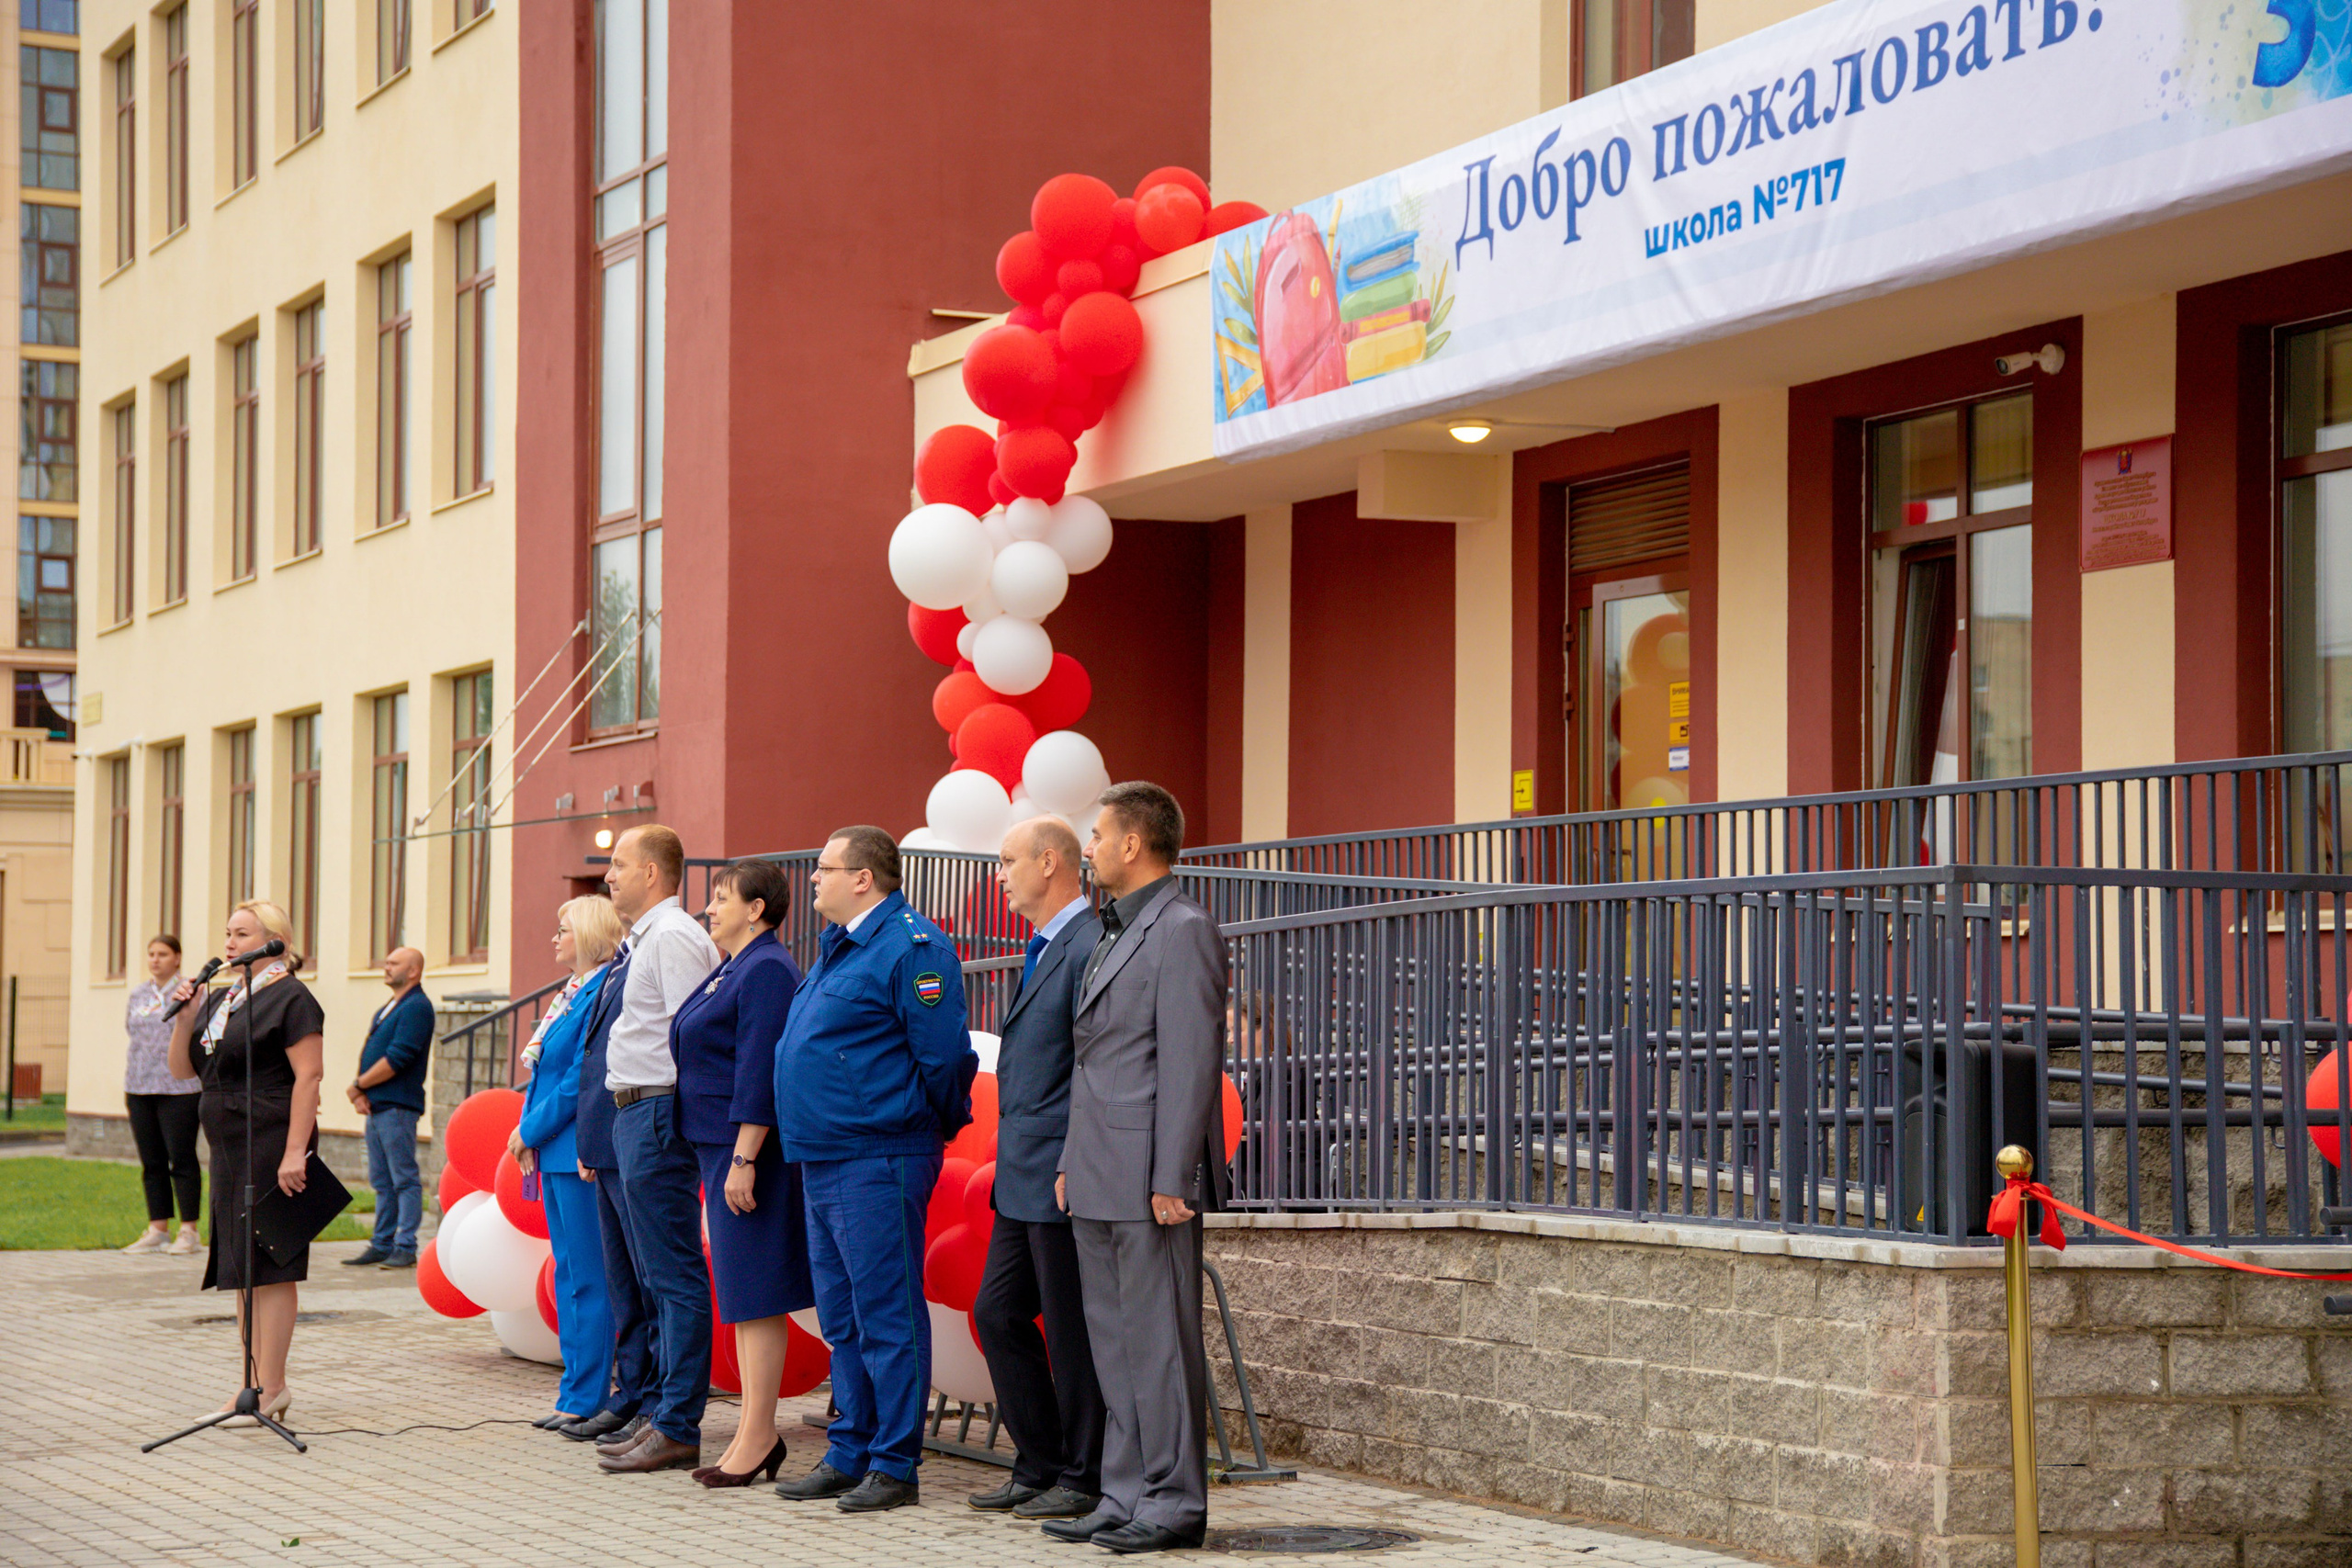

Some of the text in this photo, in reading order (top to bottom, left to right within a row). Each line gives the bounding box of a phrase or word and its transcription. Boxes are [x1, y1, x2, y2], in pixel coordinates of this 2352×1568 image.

[1455, 124, 1631, 272] Добро
[1645, 157, 1846, 259] школа №717
